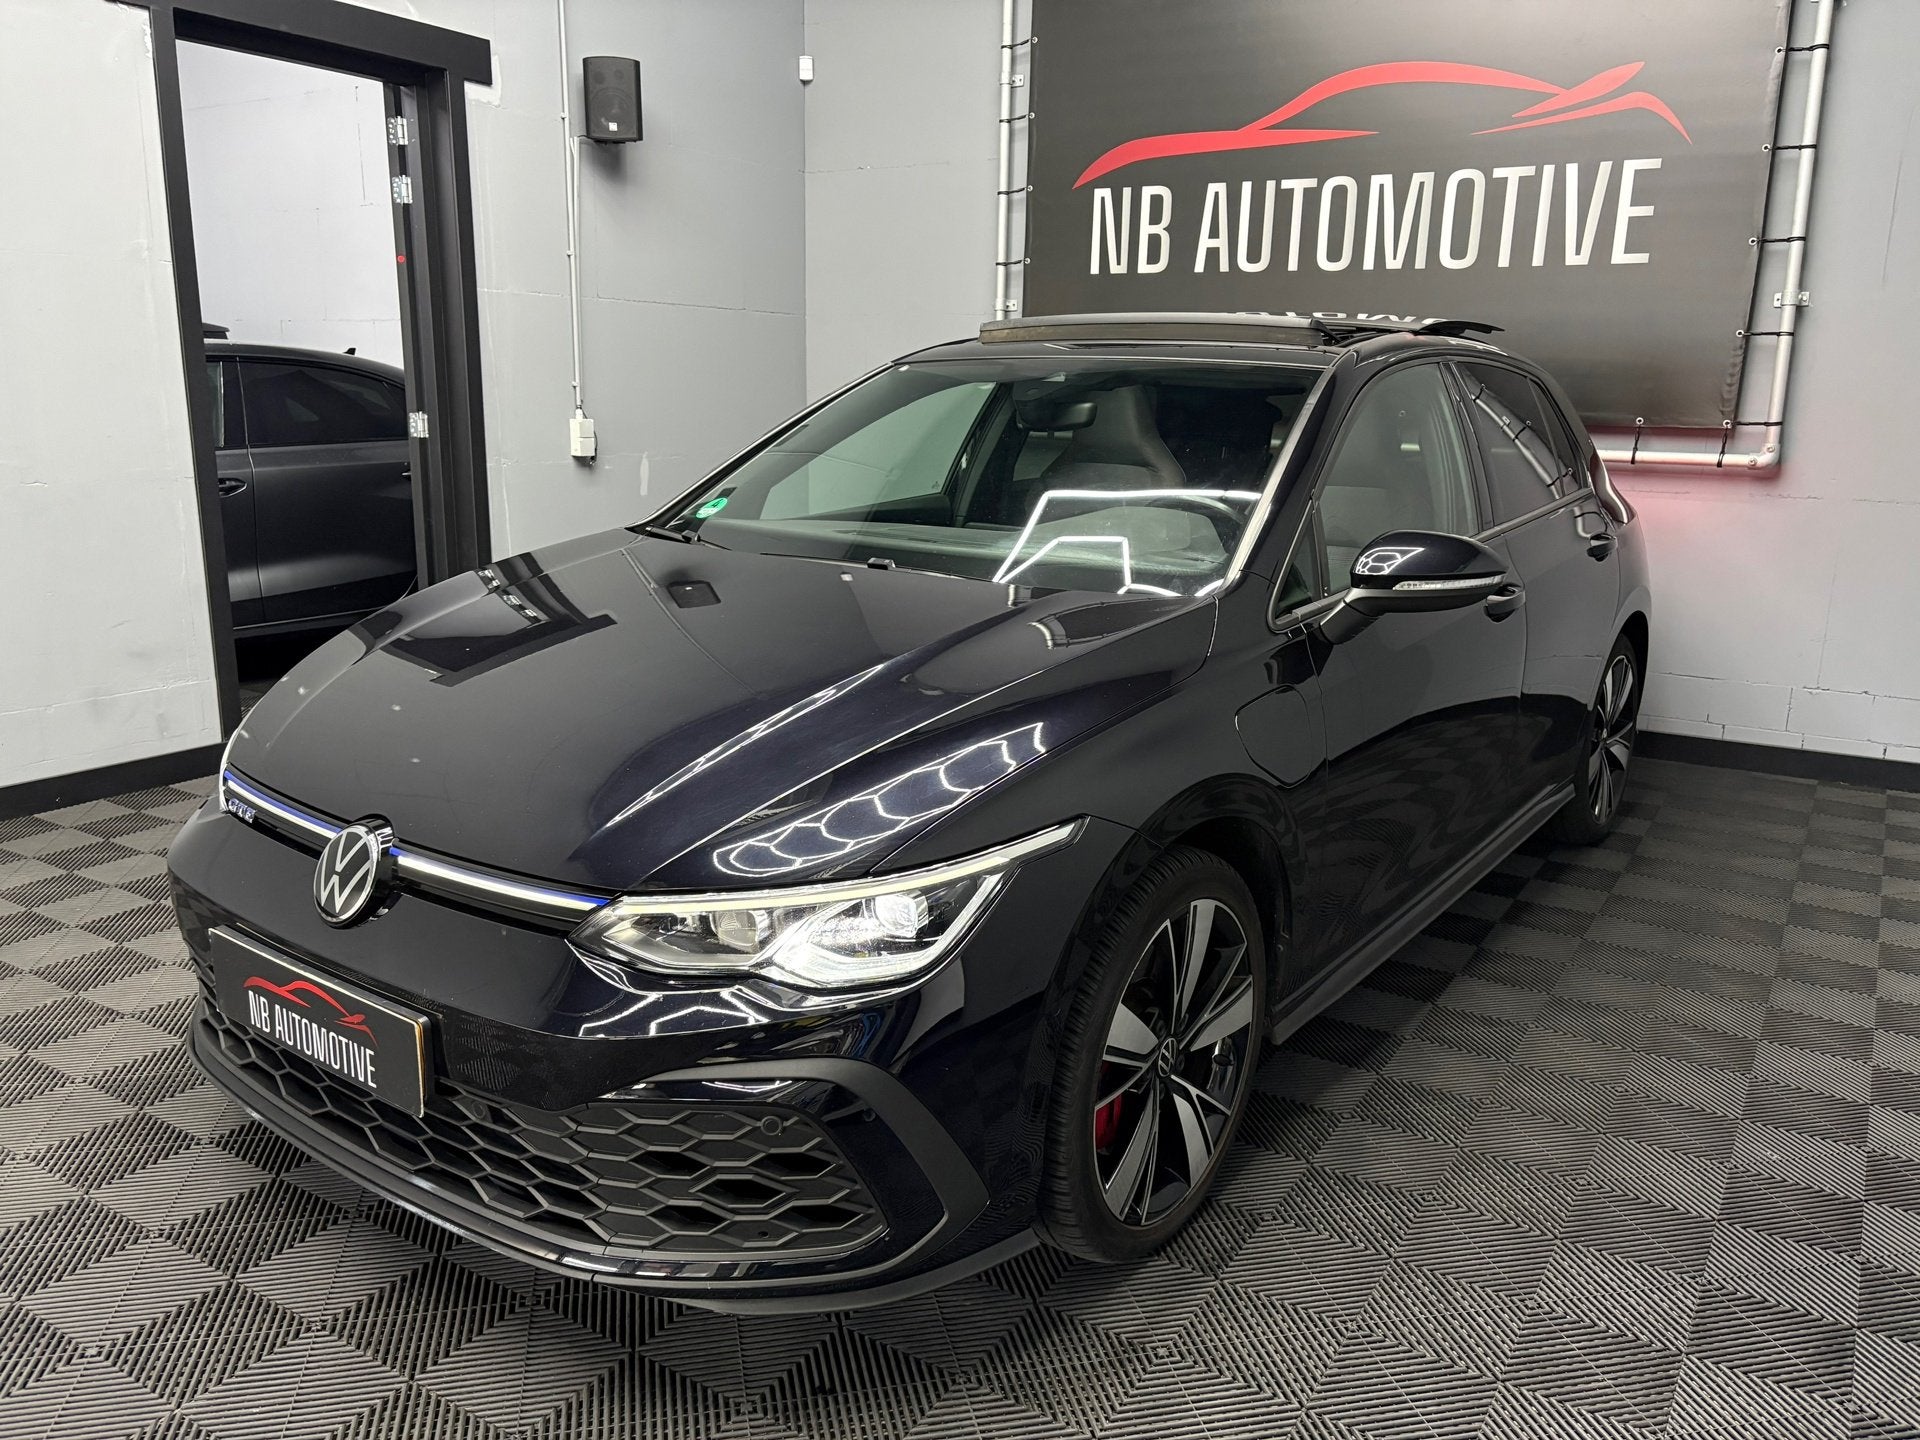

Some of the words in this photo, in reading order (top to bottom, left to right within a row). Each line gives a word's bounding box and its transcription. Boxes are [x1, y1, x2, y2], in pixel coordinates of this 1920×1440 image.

[1090, 185, 1172, 275] NB
[1194, 157, 1663, 274] AUTOMOTIVE
[248, 990, 271, 1033] NB
[275, 1003, 377, 1089] AUTOMOTIVE
